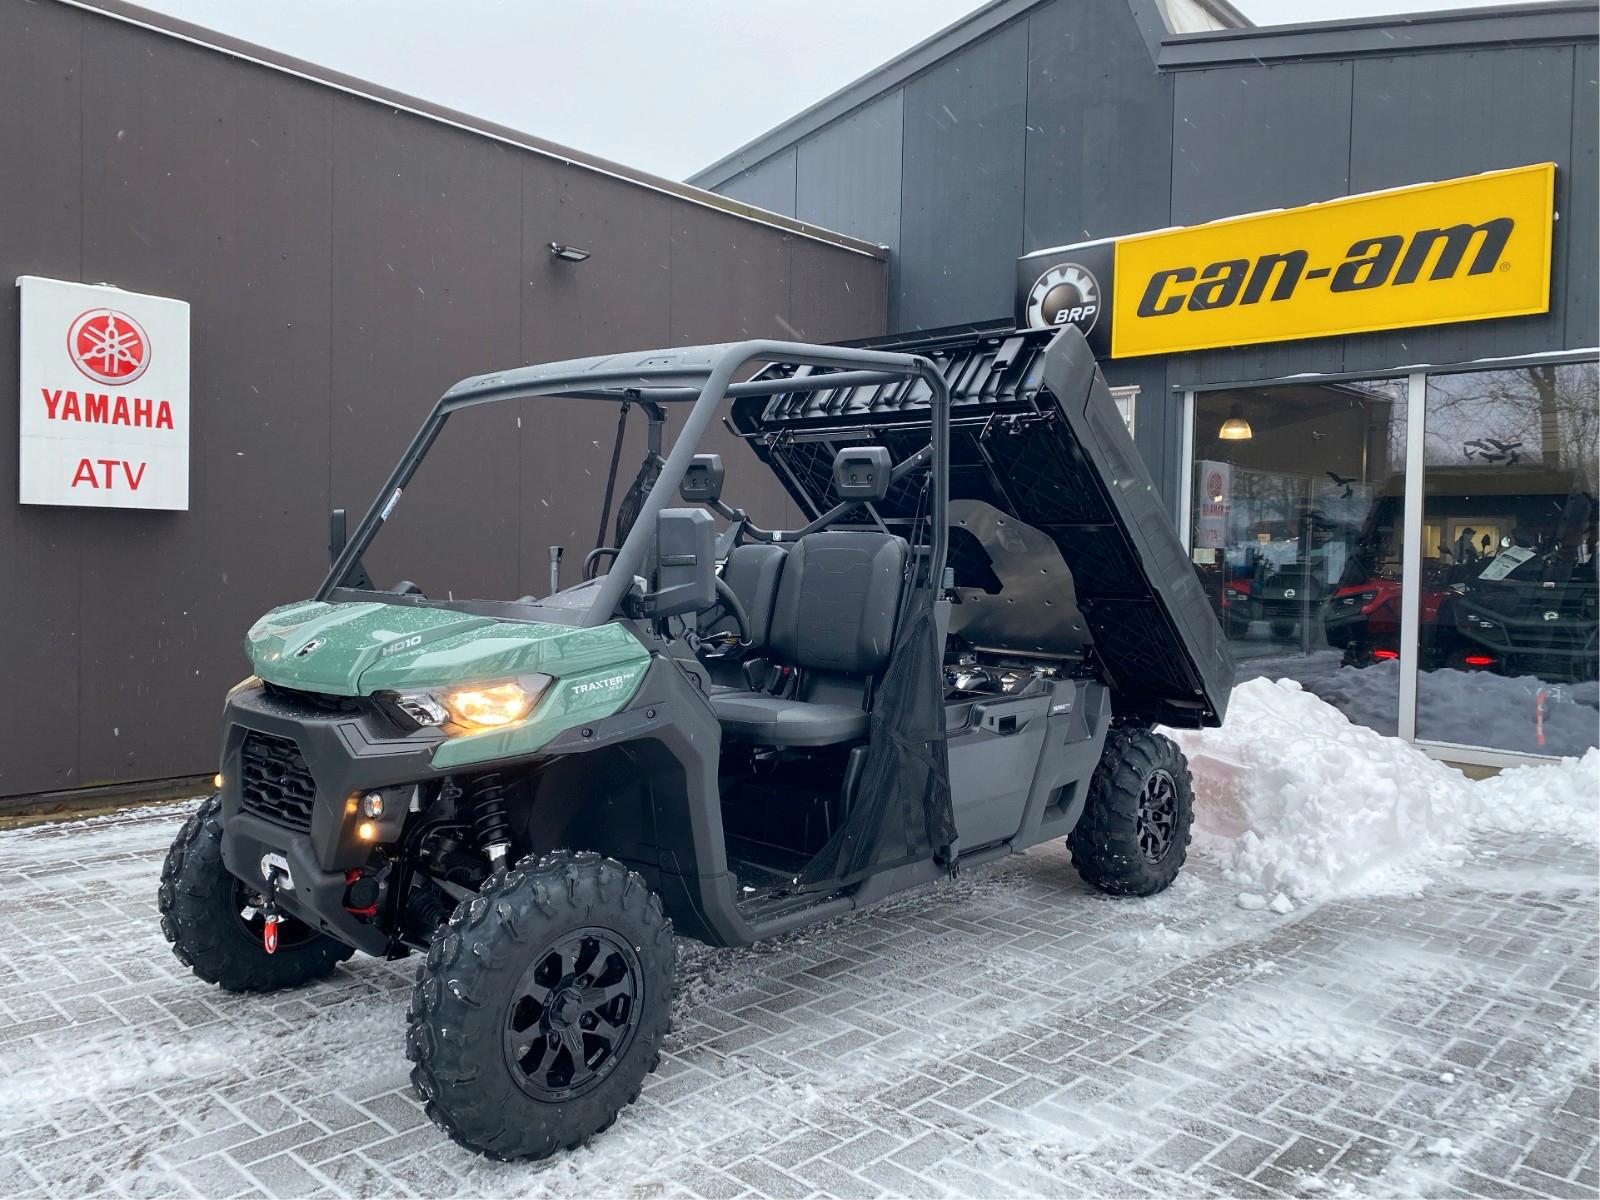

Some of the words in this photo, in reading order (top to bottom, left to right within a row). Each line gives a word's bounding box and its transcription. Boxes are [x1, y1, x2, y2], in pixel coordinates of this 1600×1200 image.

[1054, 305, 1096, 324] BRP
[41, 388, 175, 430] YAMAHA
[71, 458, 147, 491] ATV
[382, 635, 422, 656] HD10
[571, 676, 623, 695] TRAXTER
